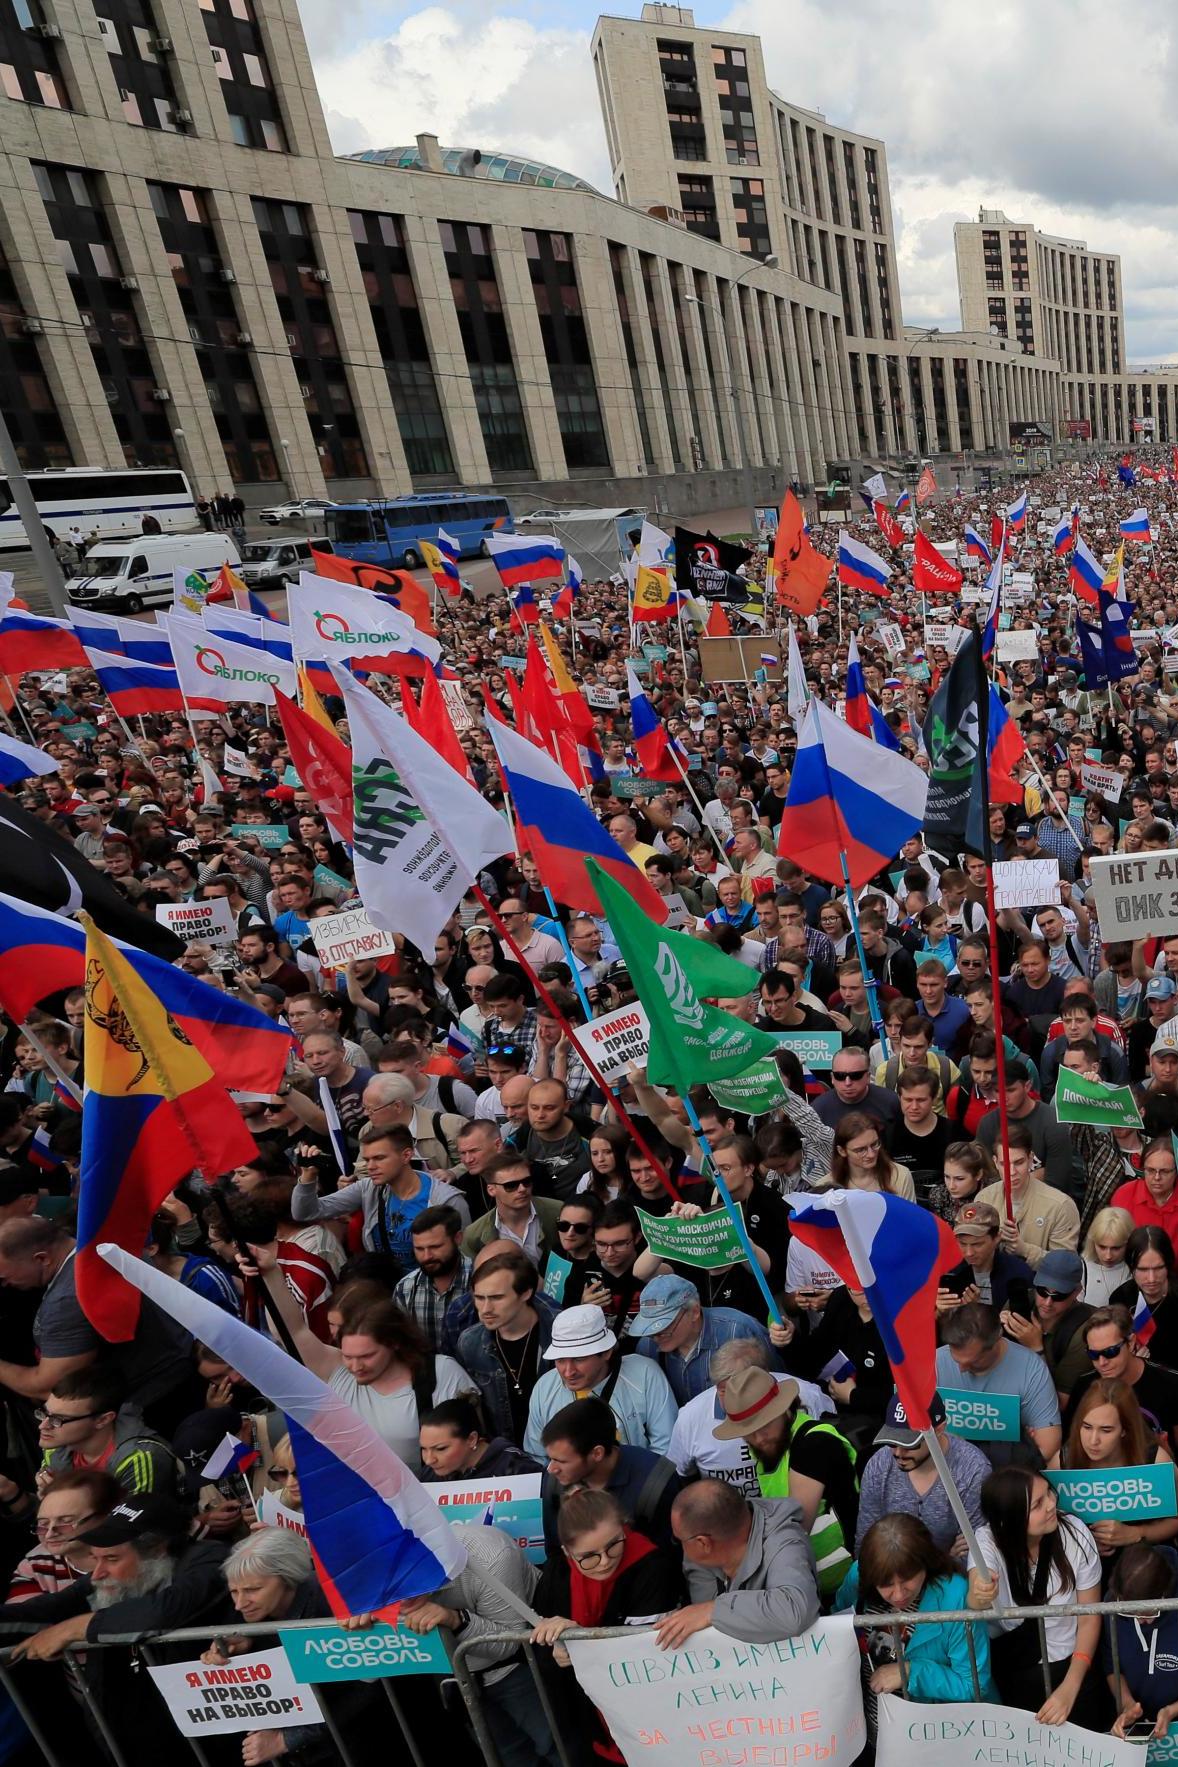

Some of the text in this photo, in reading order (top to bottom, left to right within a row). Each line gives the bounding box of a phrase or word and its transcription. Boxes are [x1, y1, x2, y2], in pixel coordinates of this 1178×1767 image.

[333, 630, 400, 645] ЯБЛОКО
[214, 665, 280, 685] ЯБЛОКО
[618, 780, 656, 788] ЛЮБОВЬ
[1083, 776, 1096, 787] НАМ
[1089, 773, 1113, 784] ХВАТИТ
[1015, 876, 1041, 890] ИЛИ
[1109, 861, 1148, 886] НЕТ
[168, 907, 212, 921] Я ИМЕЮ
[1115, 891, 1165, 923] ОИК
[172, 918, 212, 932] ПРАВО
[177, 925, 227, 942] ВЫБОР!
[318, 932, 389, 965] В ОТСТАВКУ!
[591, 1013, 641, 1043] Я ИМЕЮ
[603, 1028, 643, 1054] ПРАВО
[776, 1040, 829, 1050] ЮБОВЬ
[596, 1041, 649, 1074] НА ВЫБО
[798, 1051, 834, 1061] БОЛЬ
[1062, 1088, 1124, 1110] ДОПУСКАЙ!
[643, 1217, 669, 1233] ВЫБОР
[664, 1231, 728, 1246] УЗУРПАТОРАМ
[945, 1399, 999, 1417] БОВЬ
[945, 1413, 1006, 1431] ОБОЛЬ
[1057, 1479, 1152, 1498] ЛЮБОВЬ
[1072, 1494, 1161, 1513] СОБОЛЬ
[277, 1512, 284, 1528] Я
[305, 1635, 418, 1654] ЛЮБОВЬ
[326, 1650, 432, 1669] СОБОЛЬ
[609, 1633, 832, 1687] СОВХОЗ ИМЕНИ
[186, 1663, 272, 1688] Я ИМЕЮ
[201, 1683, 272, 1704] ПРАВО
[677, 1677, 788, 1709] ЛЕНИНА
[187, 1696, 304, 1723] НА ВЫБОР!
[639, 1711, 822, 1746] ЗА ЧЕСТНЫЕ
[909, 1719, 1015, 1742] СОВХОЗ
[700, 1736, 837, 1767] ВЫБОРЫ
